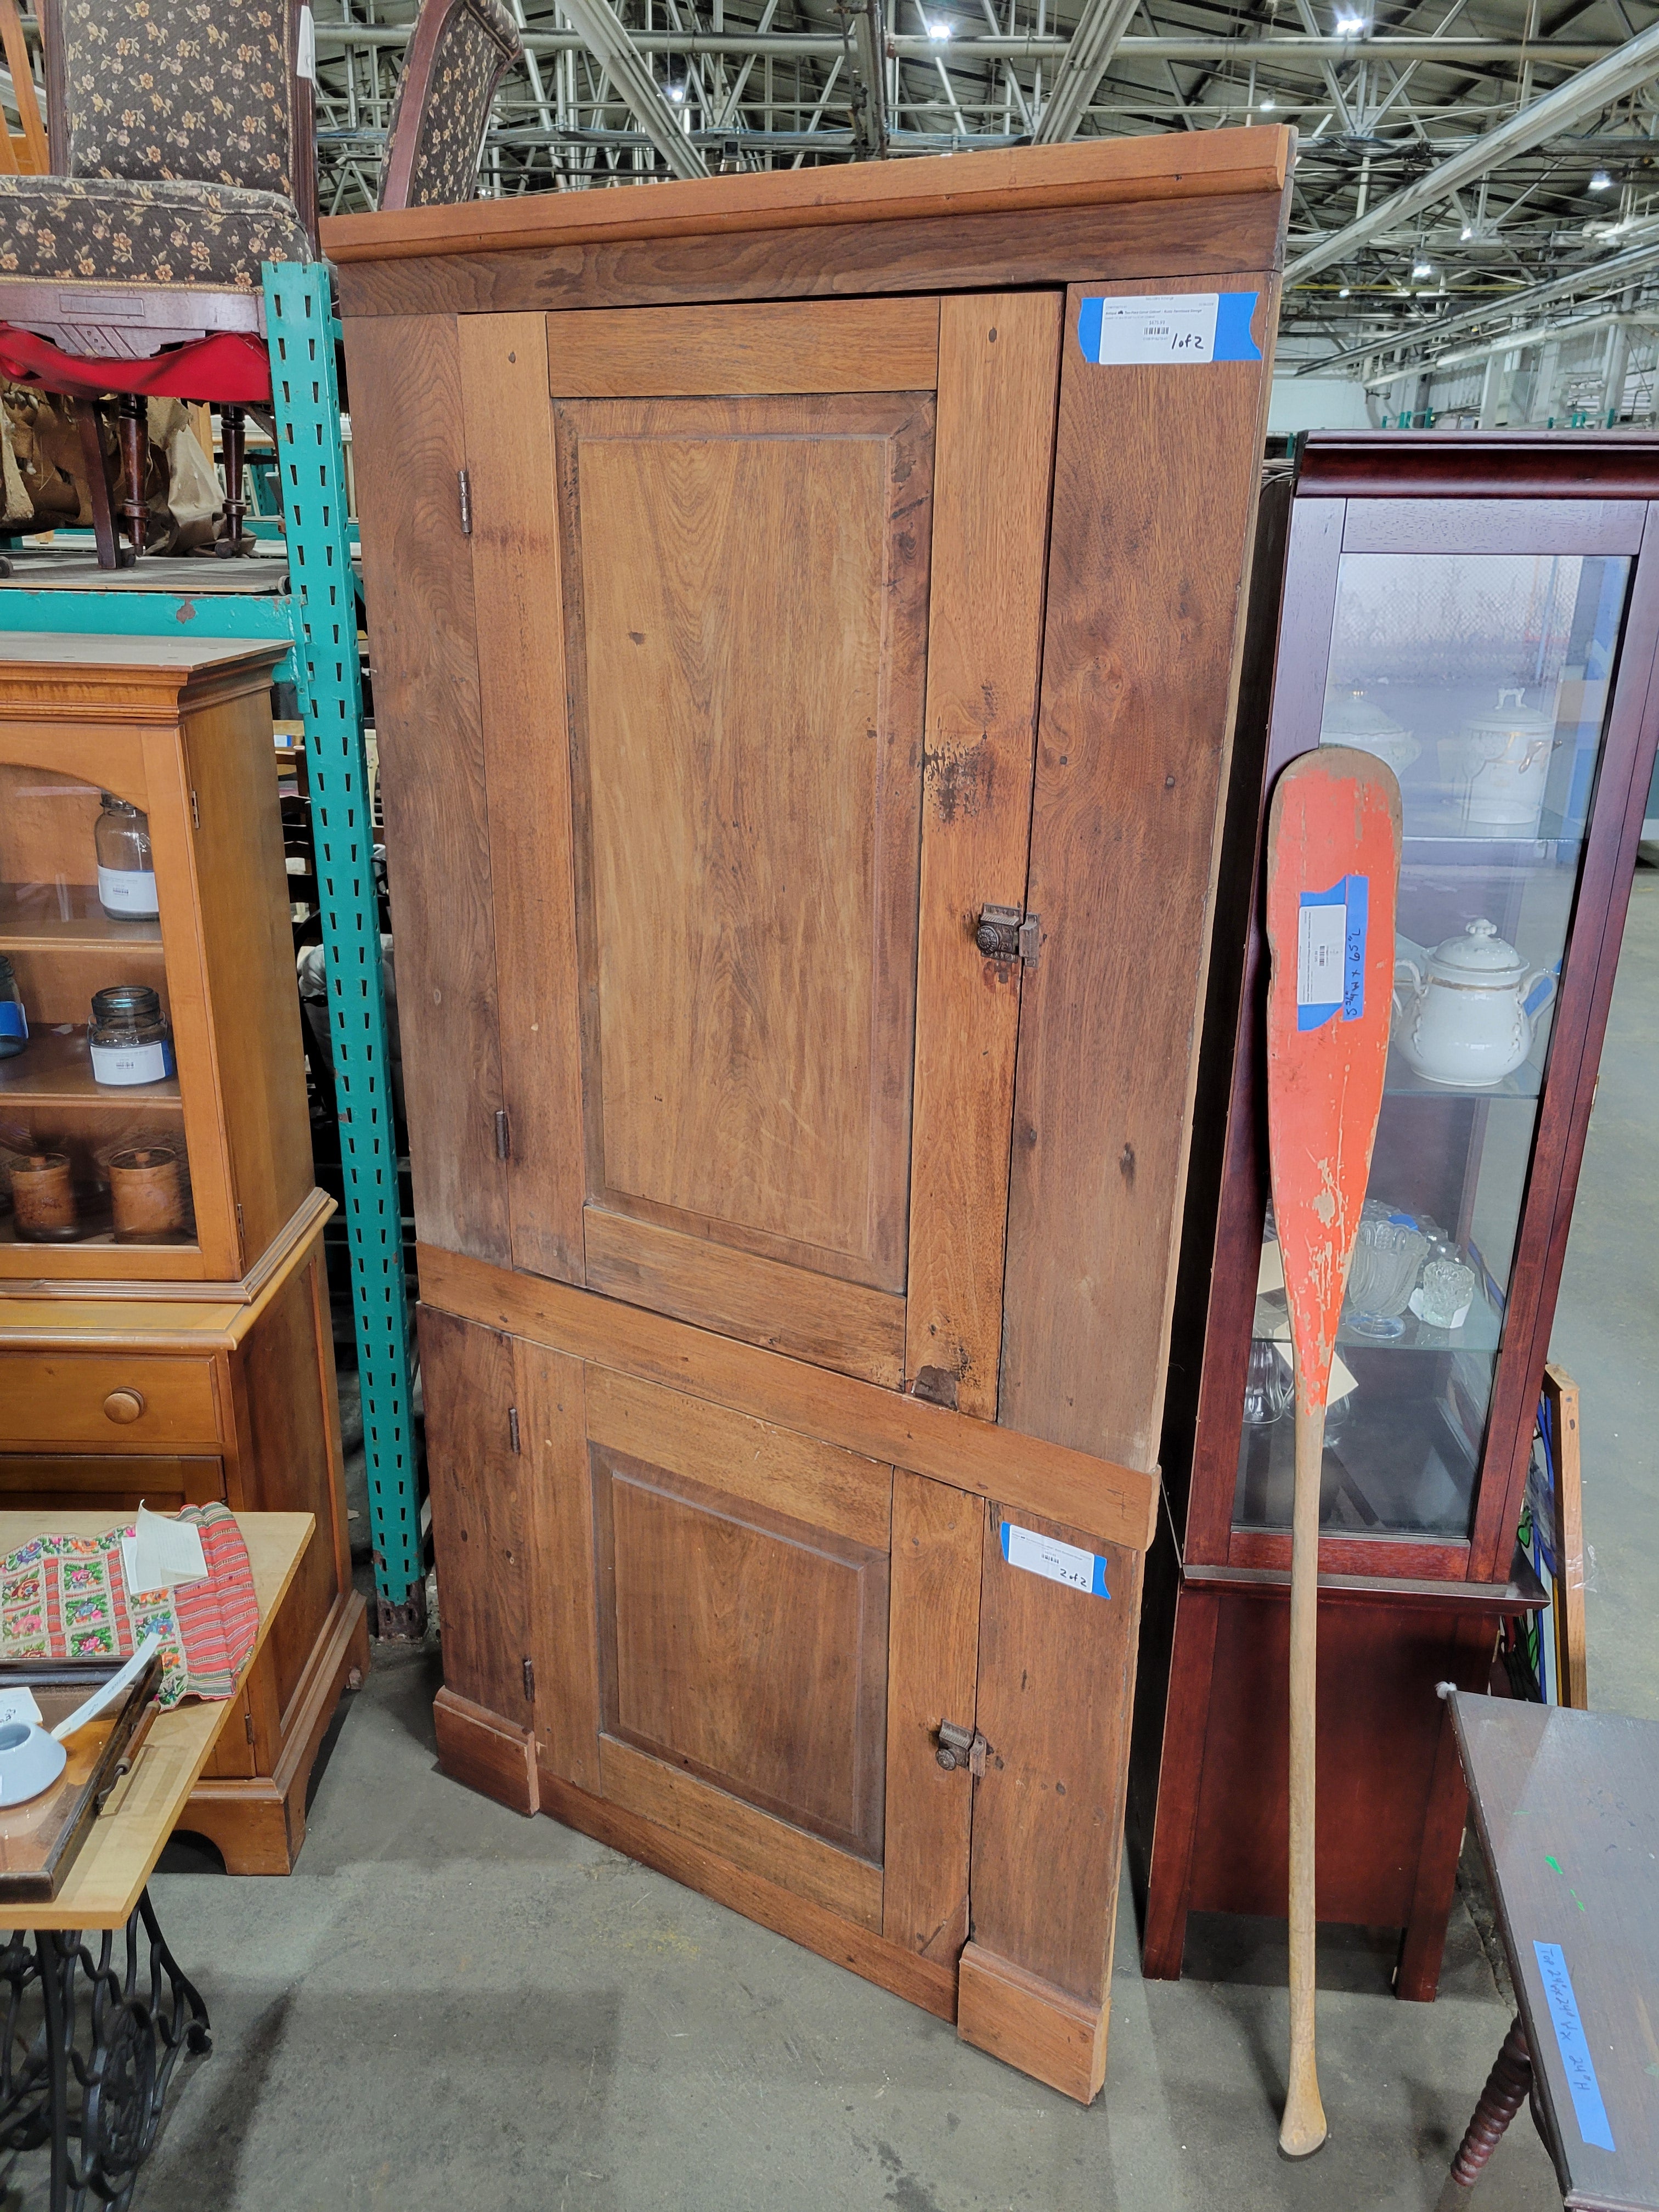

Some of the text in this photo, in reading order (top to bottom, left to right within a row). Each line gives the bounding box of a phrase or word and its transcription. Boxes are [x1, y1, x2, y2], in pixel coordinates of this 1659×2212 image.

[1171, 332, 1204, 349] 1 of 2
[1060, 1568, 1087, 1587] 2 of 2
